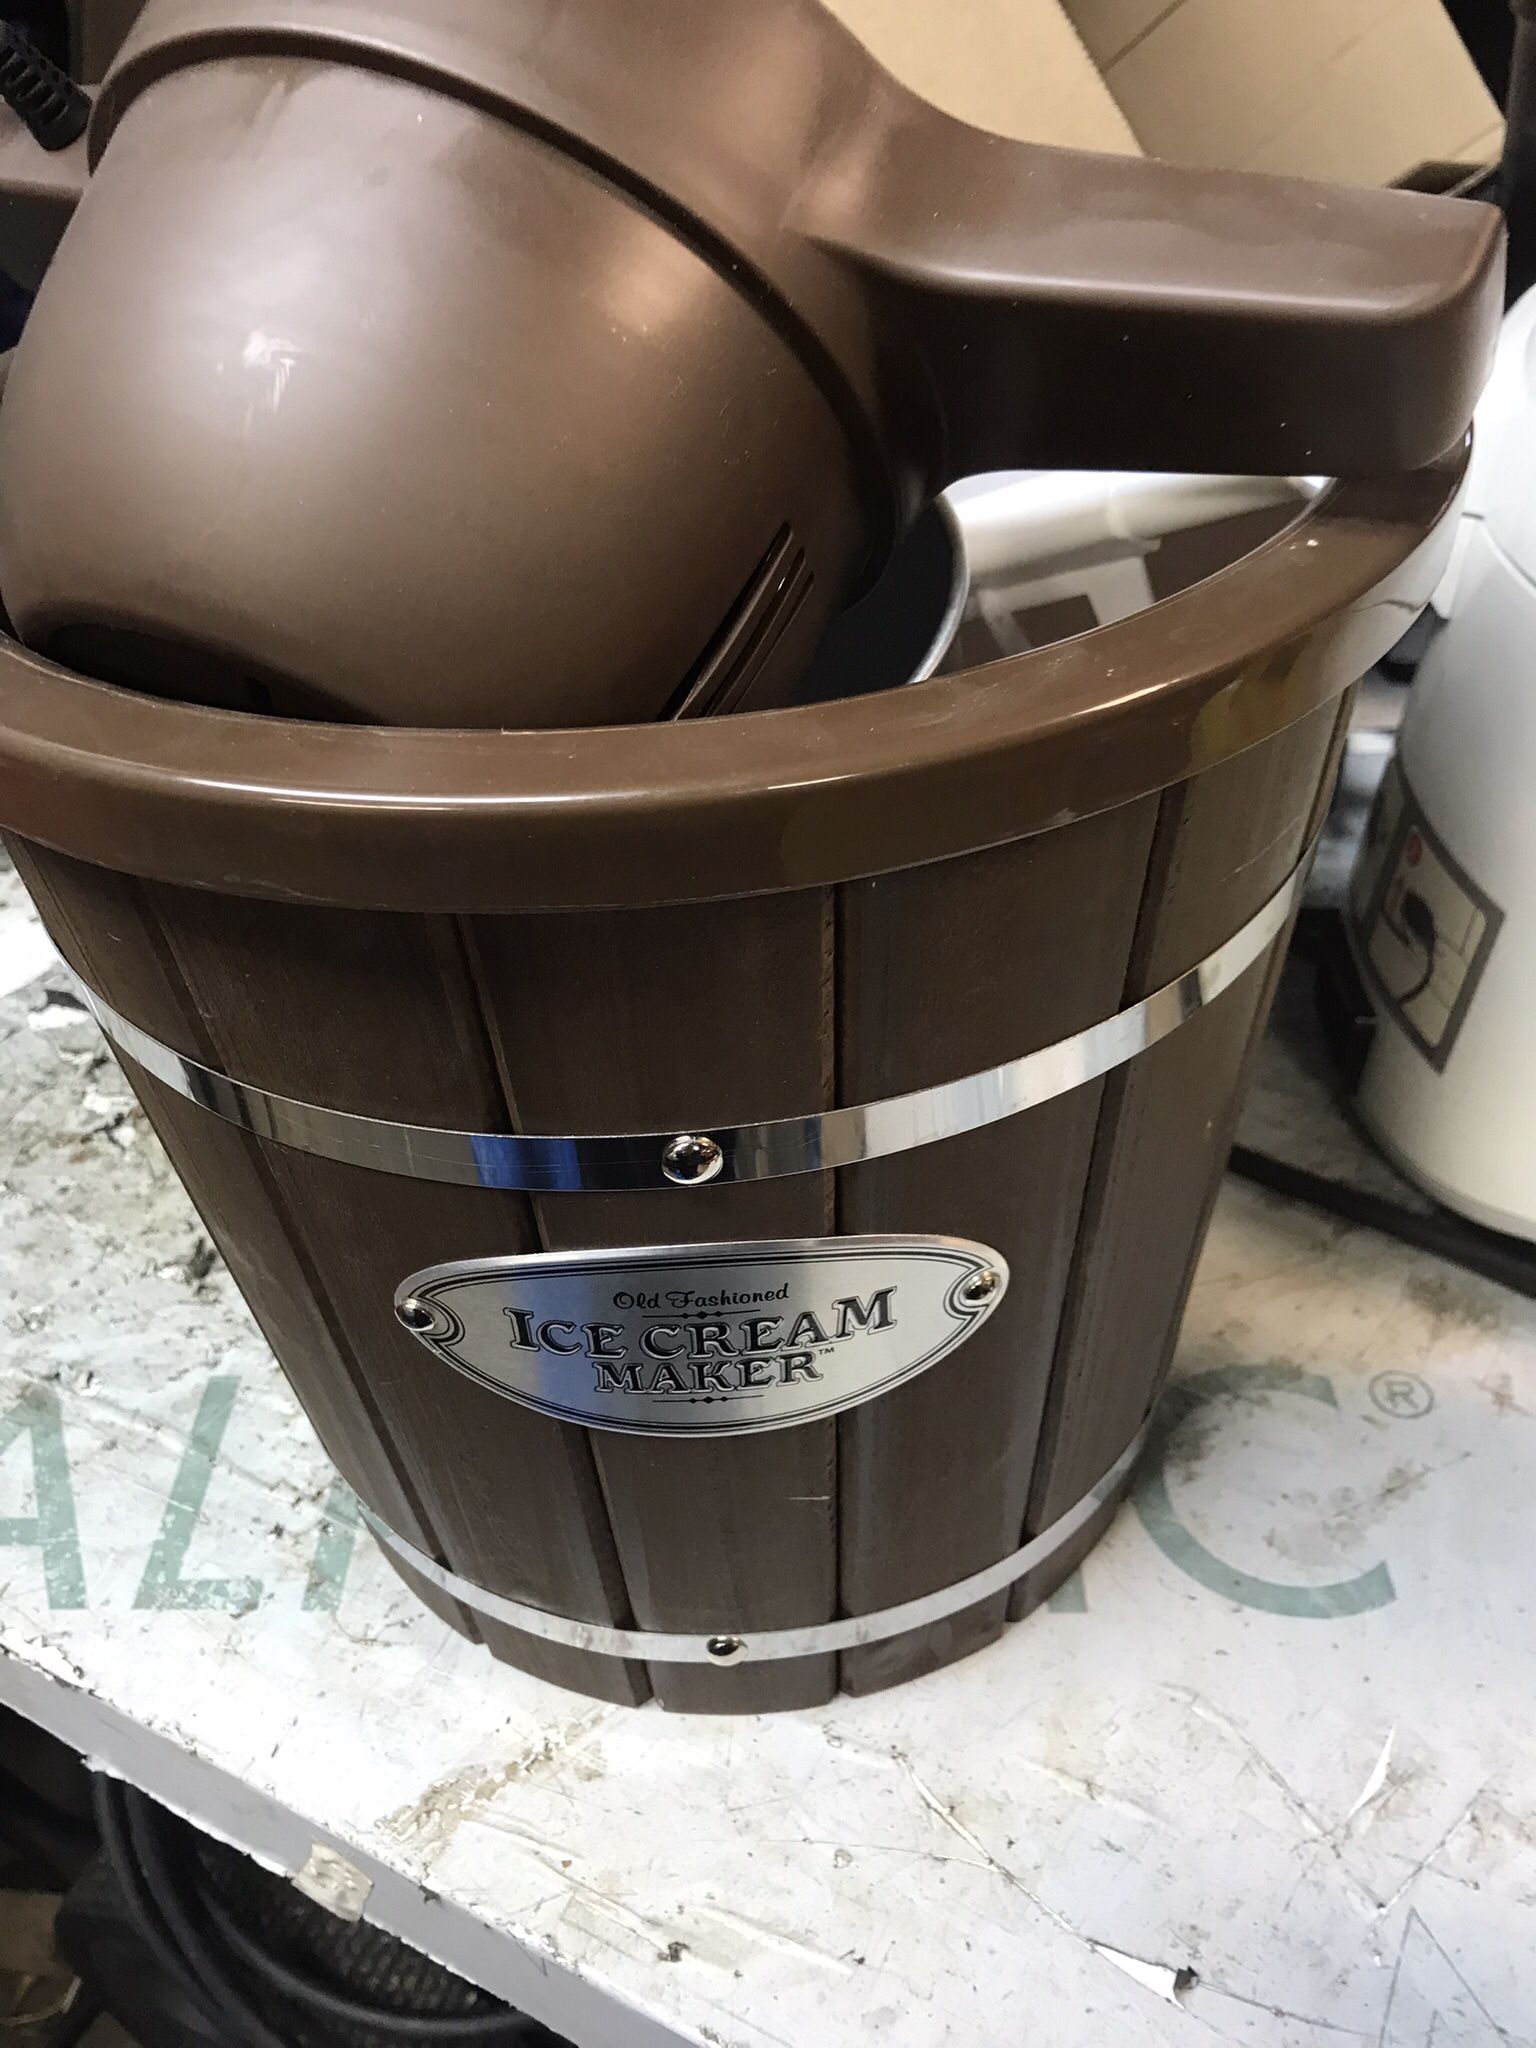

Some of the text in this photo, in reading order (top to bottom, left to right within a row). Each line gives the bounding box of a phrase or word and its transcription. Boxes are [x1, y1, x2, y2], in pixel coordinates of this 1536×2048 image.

[502, 1285, 899, 1361] ICE CREAM
[612, 1282, 791, 1312] Old Fashioned
